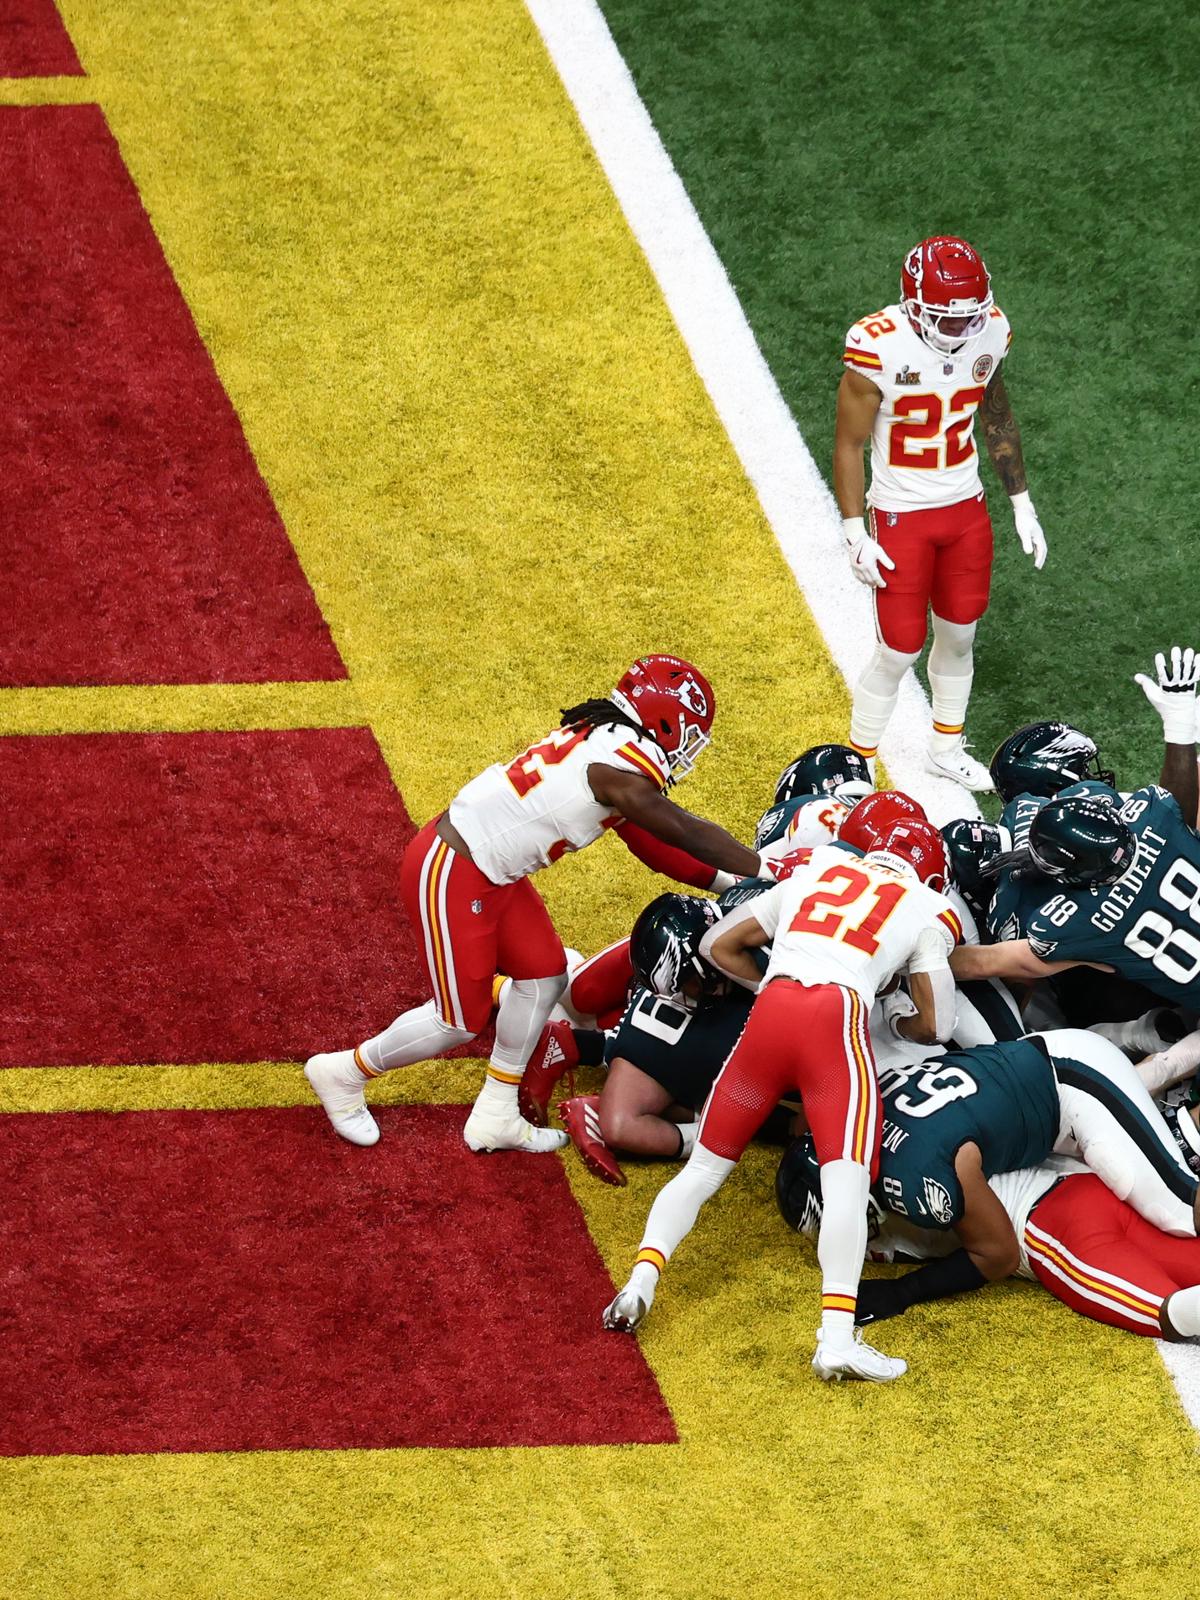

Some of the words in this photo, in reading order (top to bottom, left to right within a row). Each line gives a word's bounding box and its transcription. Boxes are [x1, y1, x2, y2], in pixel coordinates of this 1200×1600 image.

[888, 383, 988, 470] 22
[787, 864, 909, 959] 21
[1037, 894, 1079, 928] 88
[1090, 825, 1168, 933] GOEDERT
[541, 1035, 556, 1070] adidas
